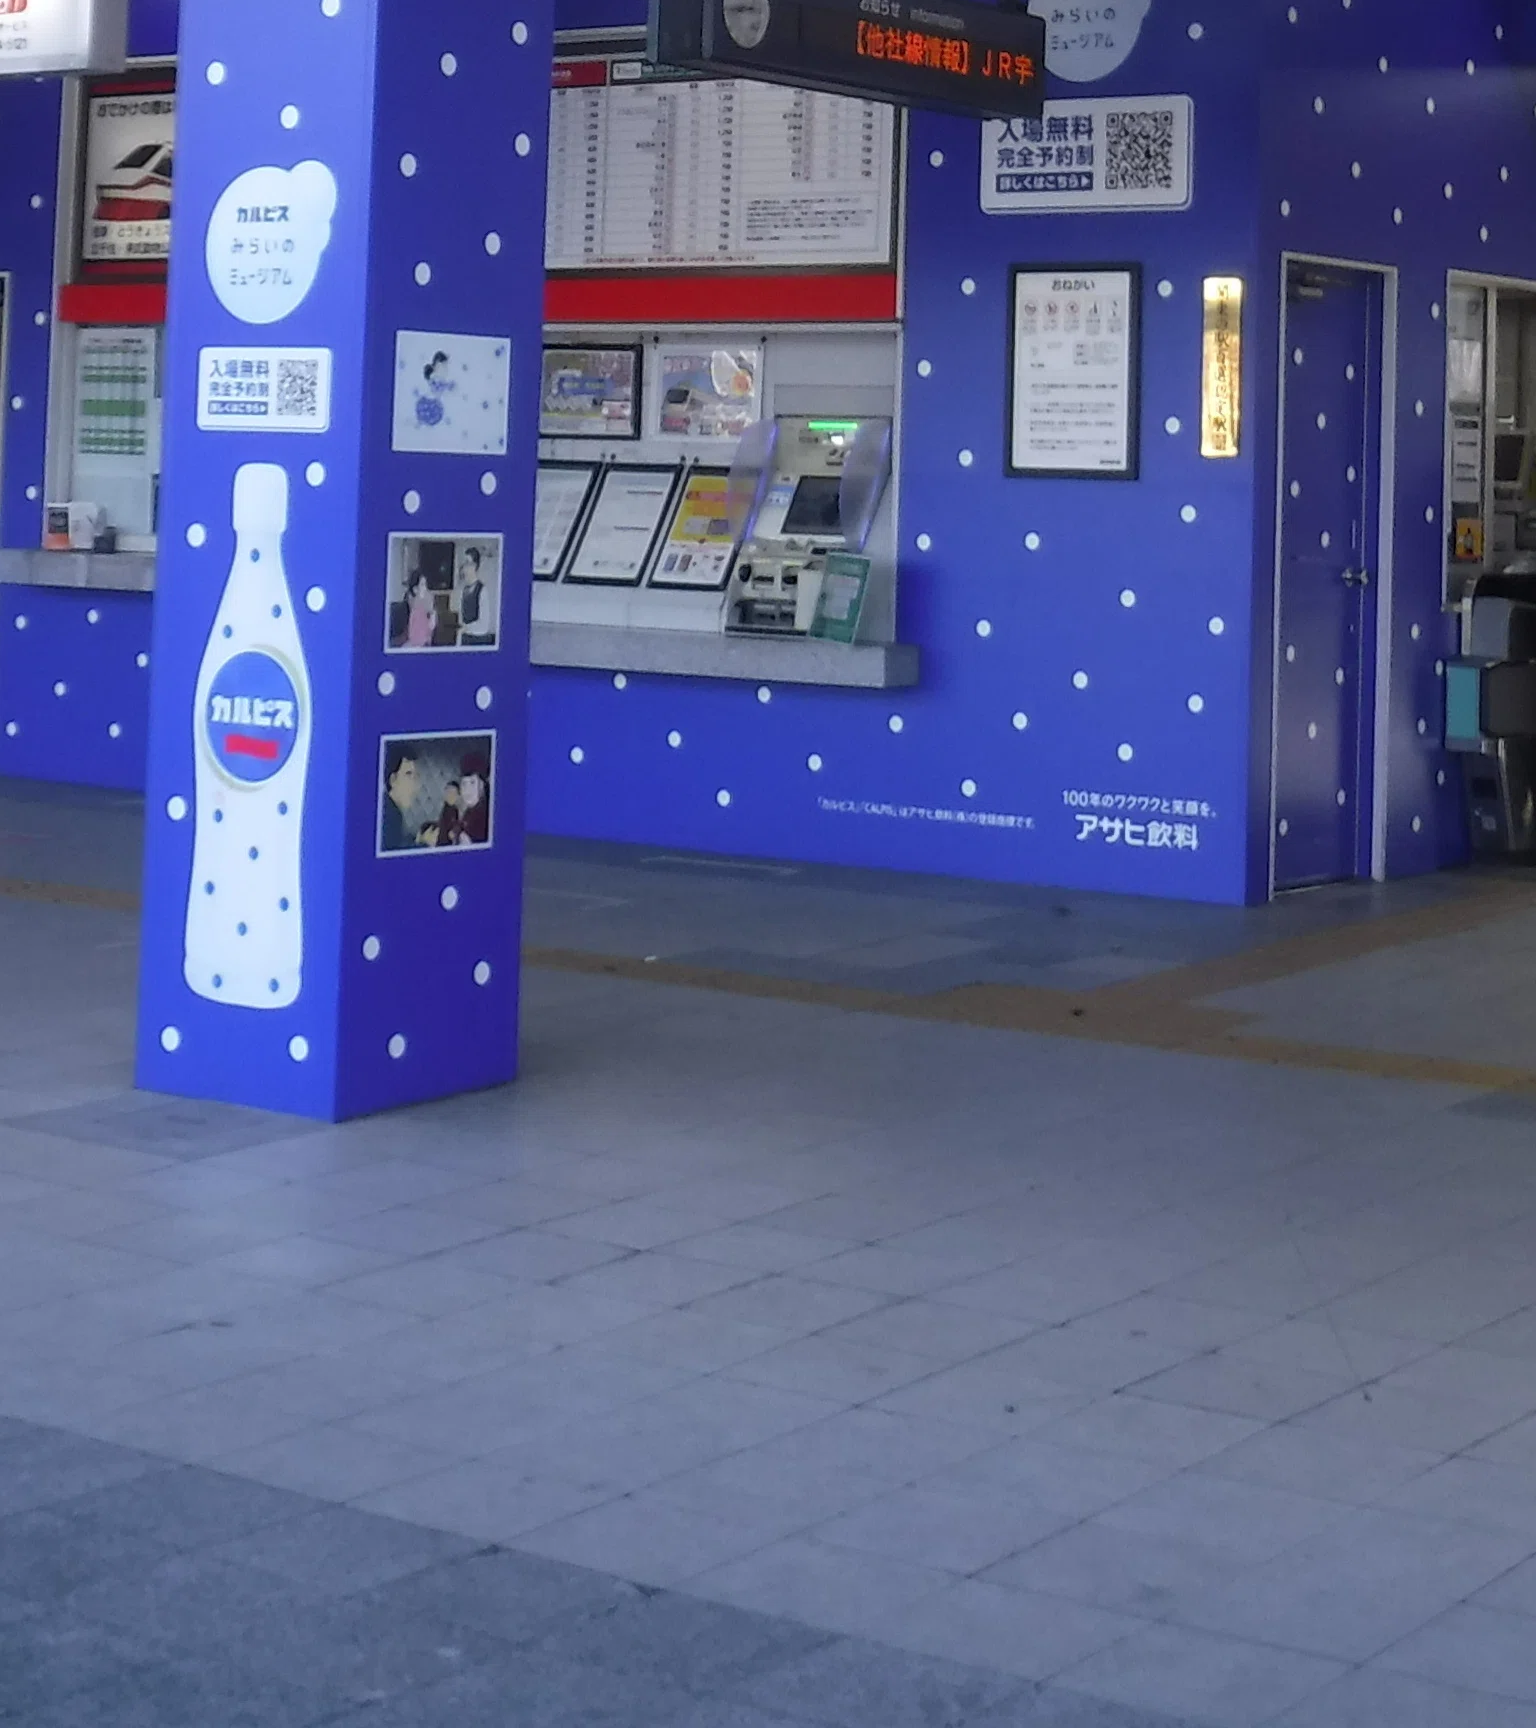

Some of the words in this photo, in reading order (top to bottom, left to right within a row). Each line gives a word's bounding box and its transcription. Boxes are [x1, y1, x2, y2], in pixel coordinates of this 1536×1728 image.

[1050, 7, 1116, 23] みらいの
[1050, 32, 1115, 50] ミュージアム
[997, 114, 1094, 143] 入場無料
[997, 144, 1094, 169] 完全予約制
[236, 205, 290, 223] カルピス
[230, 237, 295, 255] みらいの
[229, 267, 293, 286] ミュージアム
[1051, 278, 1096, 292] おねがい
[210, 692, 294, 730] カルピス
[1074, 813, 1199, 852] アサヒ飲料
